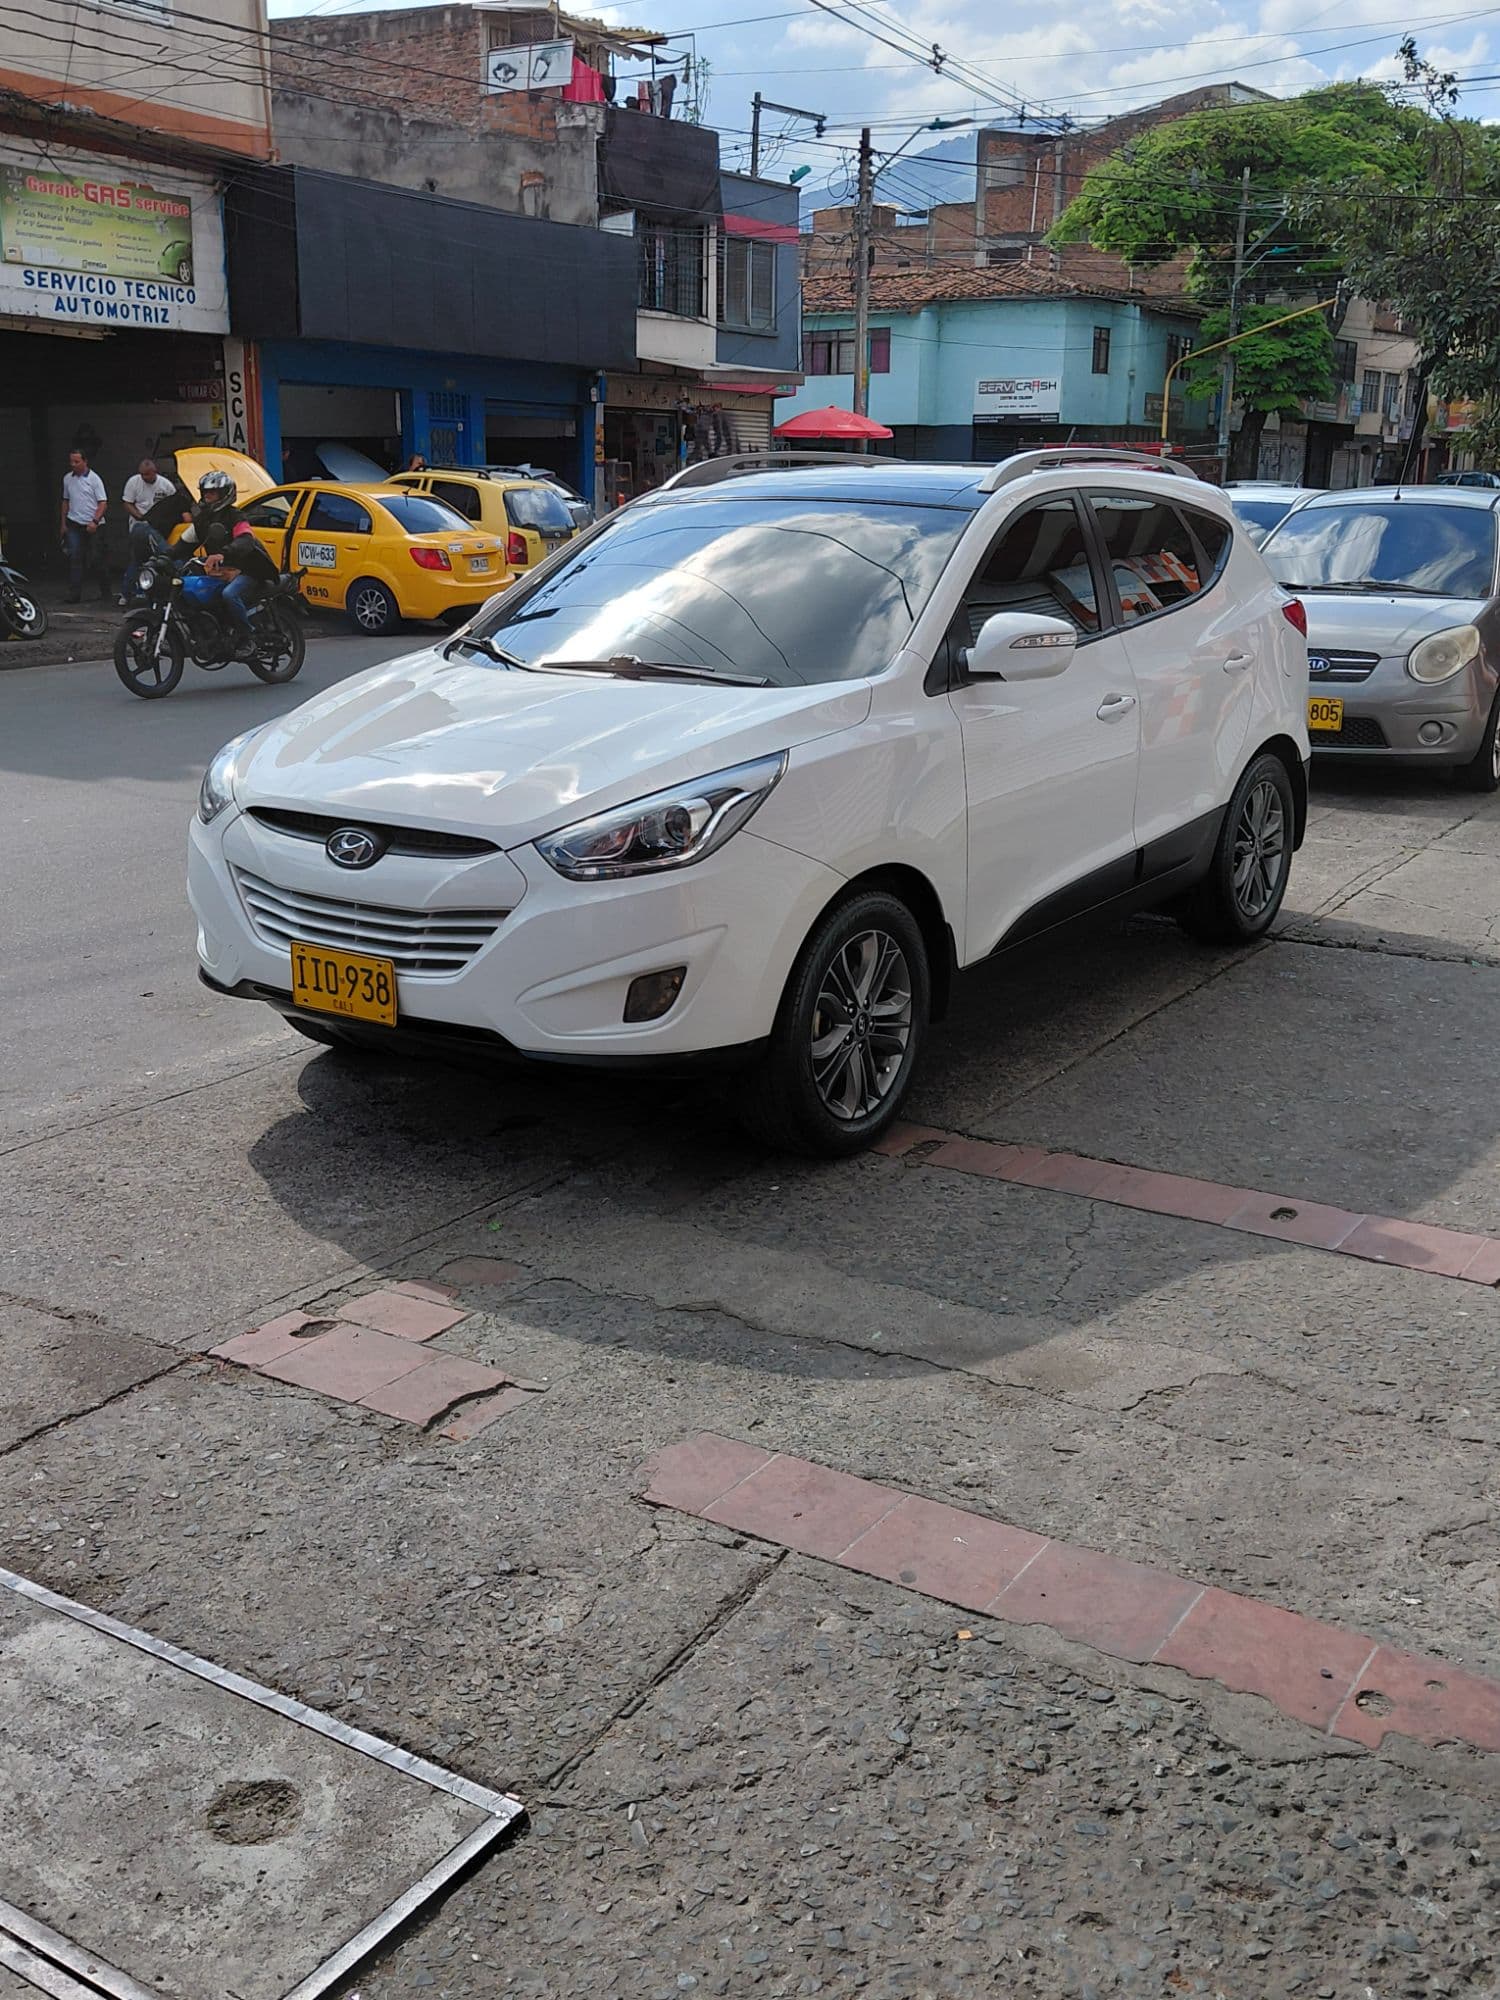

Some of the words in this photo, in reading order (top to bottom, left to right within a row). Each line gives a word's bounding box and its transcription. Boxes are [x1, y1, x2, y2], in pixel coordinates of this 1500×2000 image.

[26, 175, 80, 198] Garaje
[83, 182, 132, 208] GAS
[135, 196, 190, 218] service
[23, 269, 117, 296] SERVICIO
[124, 281, 196, 305] TECNICO
[54, 296, 170, 324] AUTOMOTRIZ
[300, 545, 335, 562] VCW-633
[306, 585, 329, 598] 8910
